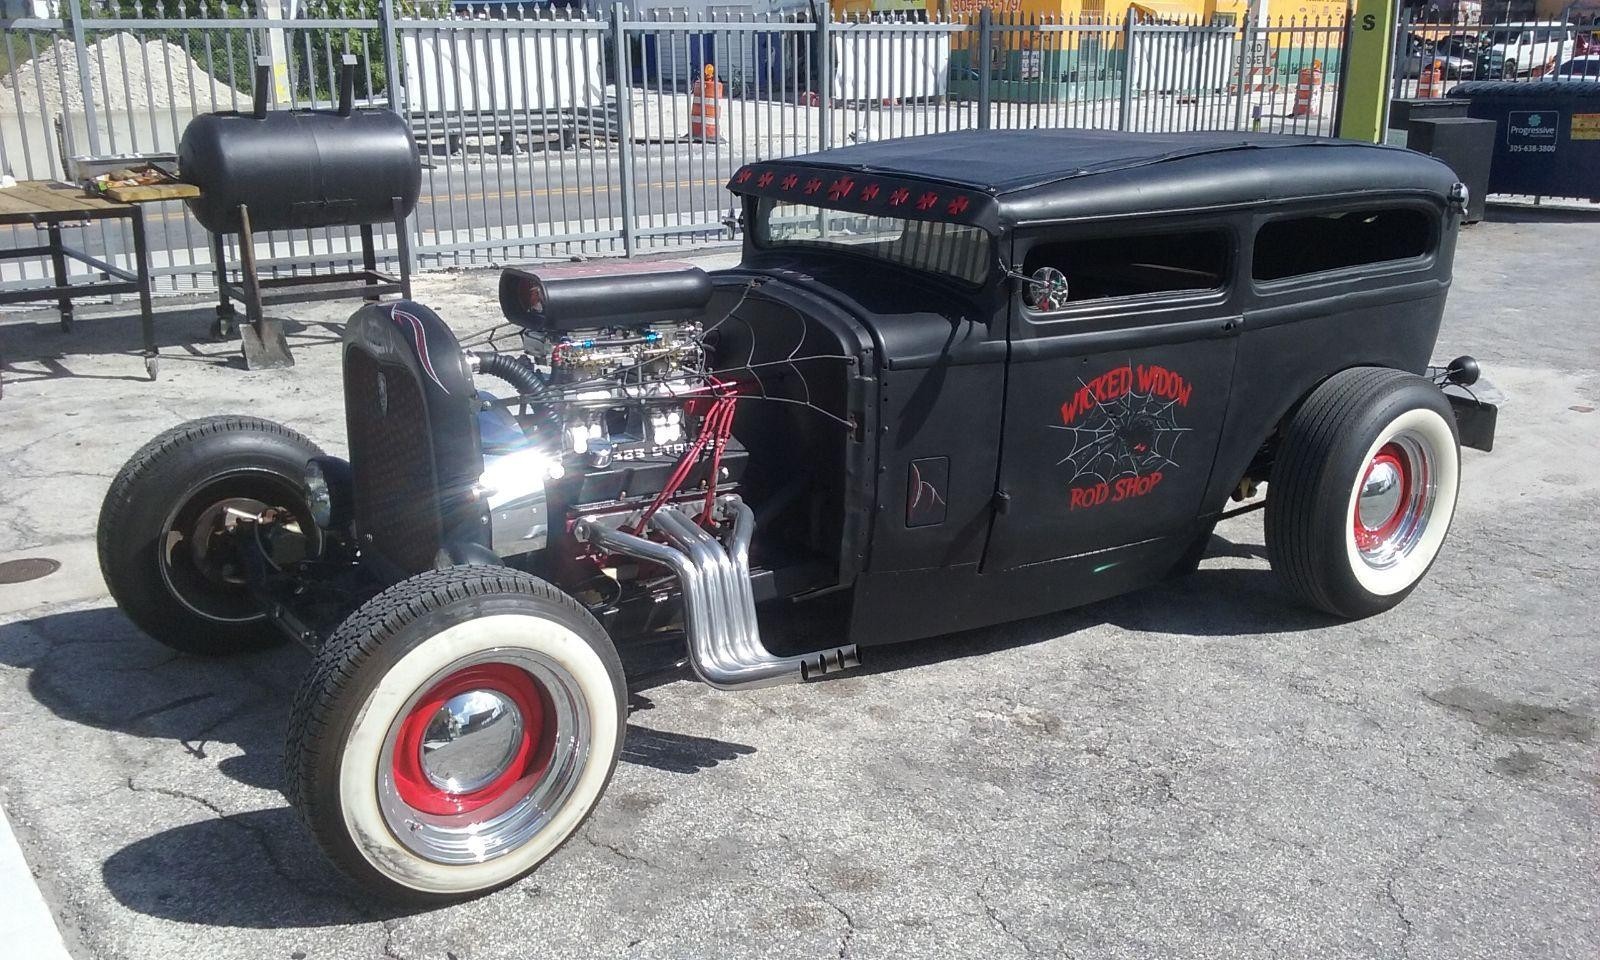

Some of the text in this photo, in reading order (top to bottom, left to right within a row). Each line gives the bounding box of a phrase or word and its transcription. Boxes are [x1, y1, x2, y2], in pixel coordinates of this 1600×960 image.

[1362, 14, 1376, 31] S
[1236, 55, 1265, 65] COSE
[1511, 126, 1554, 135] Progressive
[1060, 363, 1192, 425] WICKED WIDOW
[1070, 471, 1163, 512] ROD SHOP
